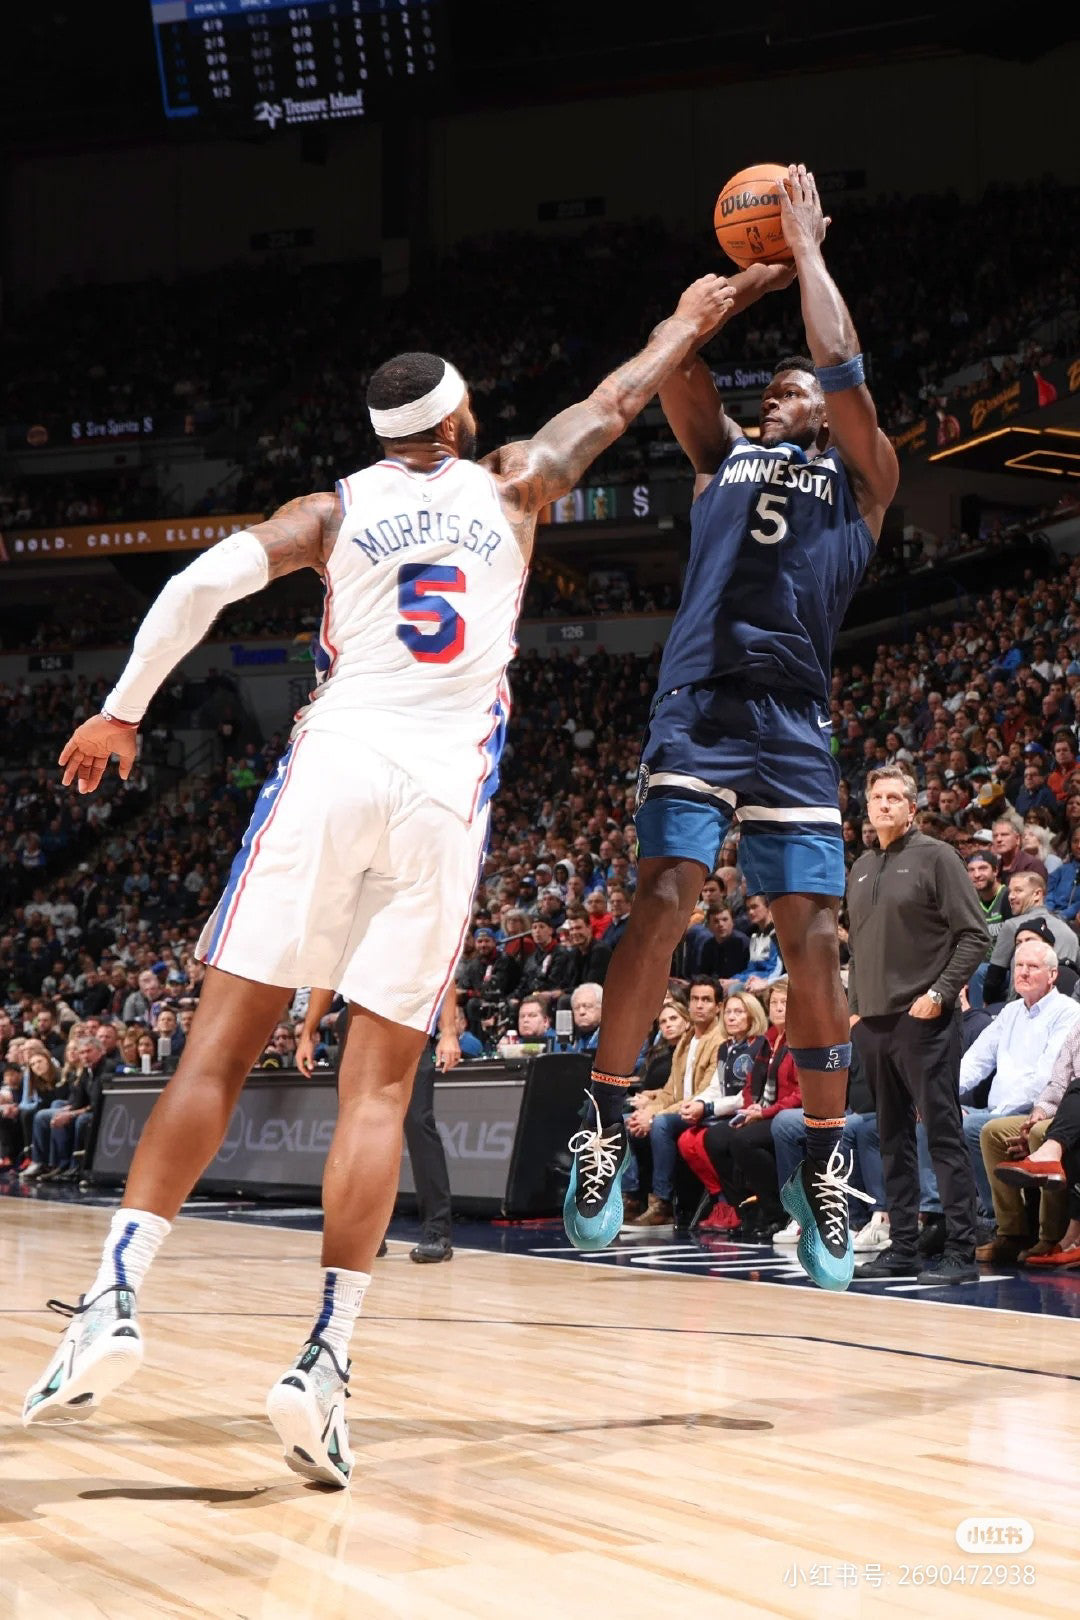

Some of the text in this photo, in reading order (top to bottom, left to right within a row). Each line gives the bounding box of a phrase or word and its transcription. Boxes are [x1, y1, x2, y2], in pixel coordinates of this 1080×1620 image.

[282, 88, 364, 116] Treasure Island
[735, 369, 772, 388] Spirits
[719, 459, 833, 505] MINNESOTA
[751, 492, 788, 545] 5
[15, 537, 73, 553] BOLD.
[87, 530, 152, 548] CRISP.
[352, 510, 460, 566] MORRIS
[396, 562, 466, 664] 5
[560, 625, 586, 641] 126
[825, 1059, 841, 1069] AE
[828, 1049, 839, 1060] 5
[434, 1120, 515, 1159] XUS
